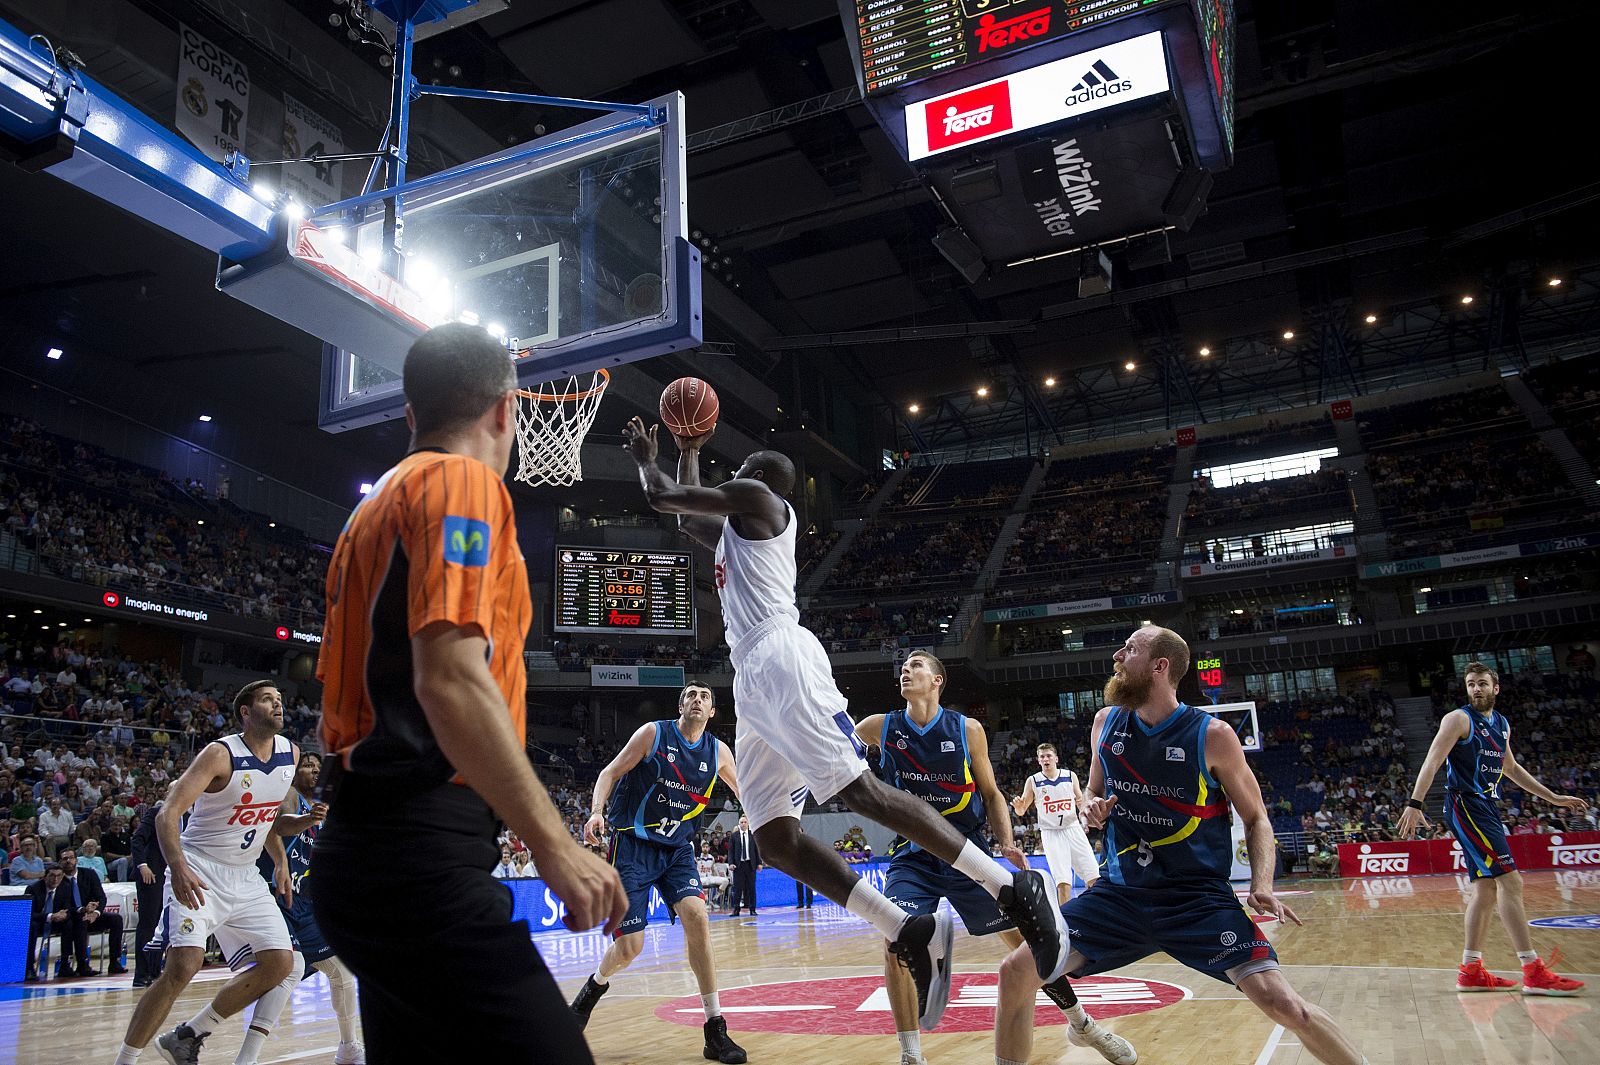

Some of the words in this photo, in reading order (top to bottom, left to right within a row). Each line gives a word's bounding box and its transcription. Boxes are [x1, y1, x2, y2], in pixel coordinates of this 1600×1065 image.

[870, 20, 895, 32] REYES
[974, 6, 1052, 53] Teka
[872, 32, 893, 43] AYON
[873, 39, 908, 54] CARROLL
[183, 30, 249, 83] COPA
[875, 51, 905, 65] HUNTER
[183, 45, 248, 97] KORAC
[876, 65, 899, 76] LLULL
[878, 74, 908, 88] SUAREZ
[1065, 77, 1133, 107] adidas
[943, 105, 994, 137] Teka
[1053, 138, 1102, 217] WiZink
[1034, 197, 1075, 237] nter
[1536, 536, 1588, 552] WiZink
[606, 554, 620, 562] 37
[630, 555, 643, 563] 27
[1215, 558, 1268, 571] Comunidad
[1271, 556, 1283, 564] de
[1286, 551, 1320, 562] Madrid
[1379, 560, 1425, 575] WiZink
[607, 584, 643, 595] 03:56
[163, 605, 174, 614] tu
[175, 608, 208, 621] energía
[996, 608, 1036, 620] WiZink
[1125, 593, 1166, 605] WiZink
[608, 609, 642, 625] Teka
[1197, 659, 1221, 670] 03:56
[597, 671, 633, 680] WiZink
[902, 771, 957, 782] MORABANC
[1114, 779, 1185, 799] MORABANC
[919, 793, 951, 803] ndorra
[1043, 795, 1072, 815] Teka
[1057, 814, 1064, 826] 7
[1127, 811, 1174, 827] Andorra
[655, 817, 681, 838] 17
[240, 828, 257, 850] 9
[1136, 838, 1154, 867] 5
[1357, 844, 1410, 874] Teka
[1208, 946, 1238, 966] ANDORRA
